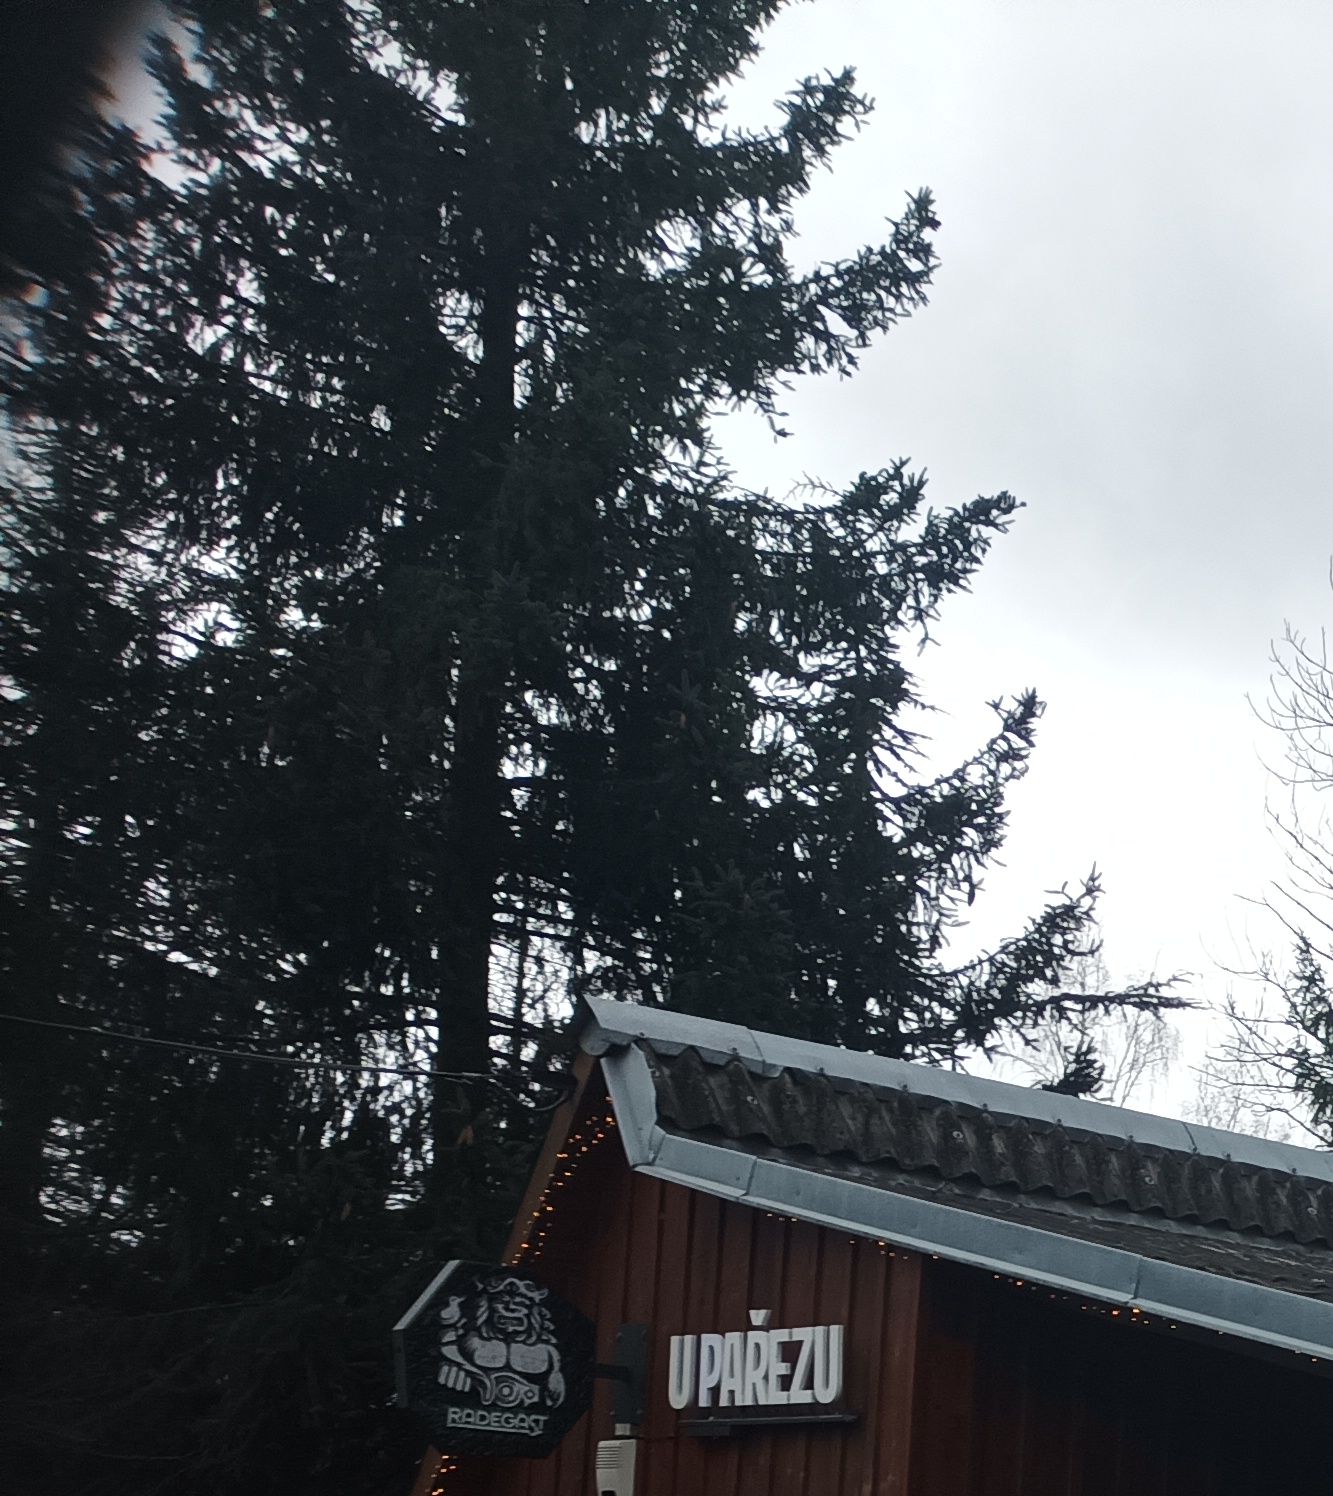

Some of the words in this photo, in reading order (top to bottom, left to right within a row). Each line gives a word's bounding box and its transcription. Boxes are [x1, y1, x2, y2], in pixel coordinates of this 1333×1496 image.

[669, 1334, 697, 1409] U
[698, 1309, 844, 1407] PAŘEZU
[446, 1407, 549, 1437] RADEGAST
